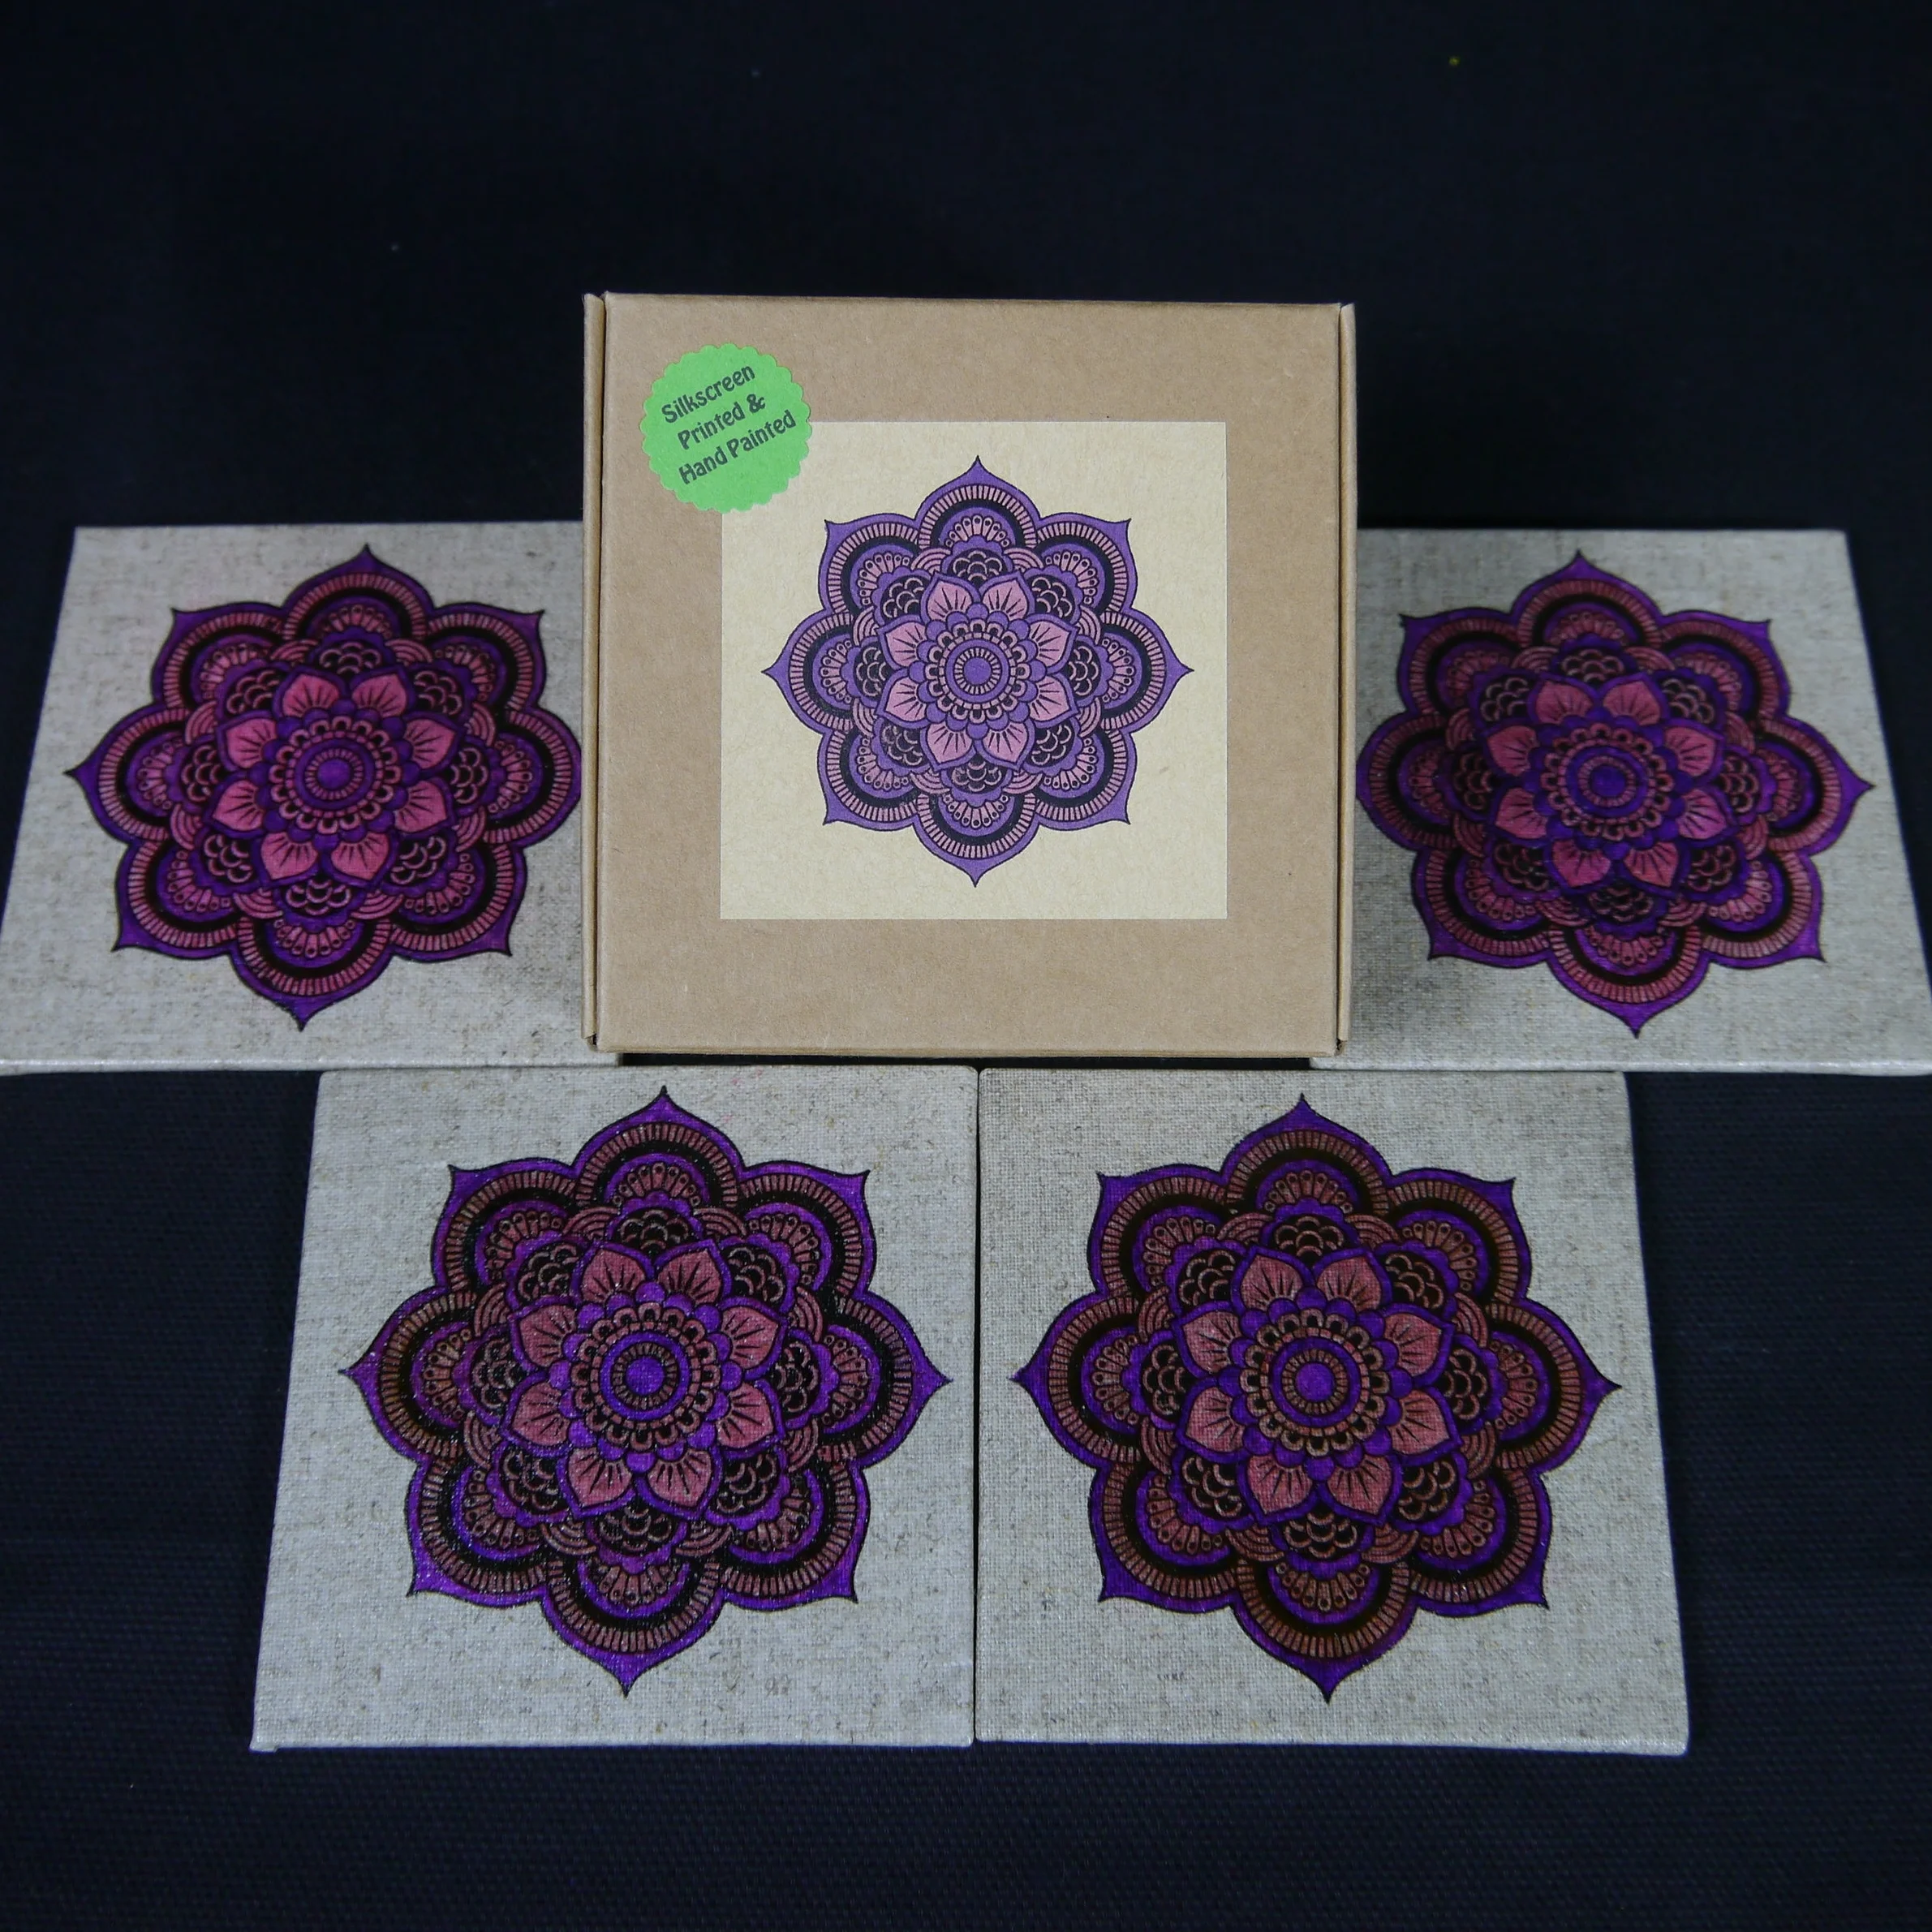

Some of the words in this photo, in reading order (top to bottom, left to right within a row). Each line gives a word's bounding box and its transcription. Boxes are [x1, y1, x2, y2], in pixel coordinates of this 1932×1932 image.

[661, 366, 755, 424] Silkscreen
[678, 401, 746, 450] Printed
[747, 394, 766, 413] &
[678, 445, 728, 484] Hand
[726, 409, 797, 458] Painted
